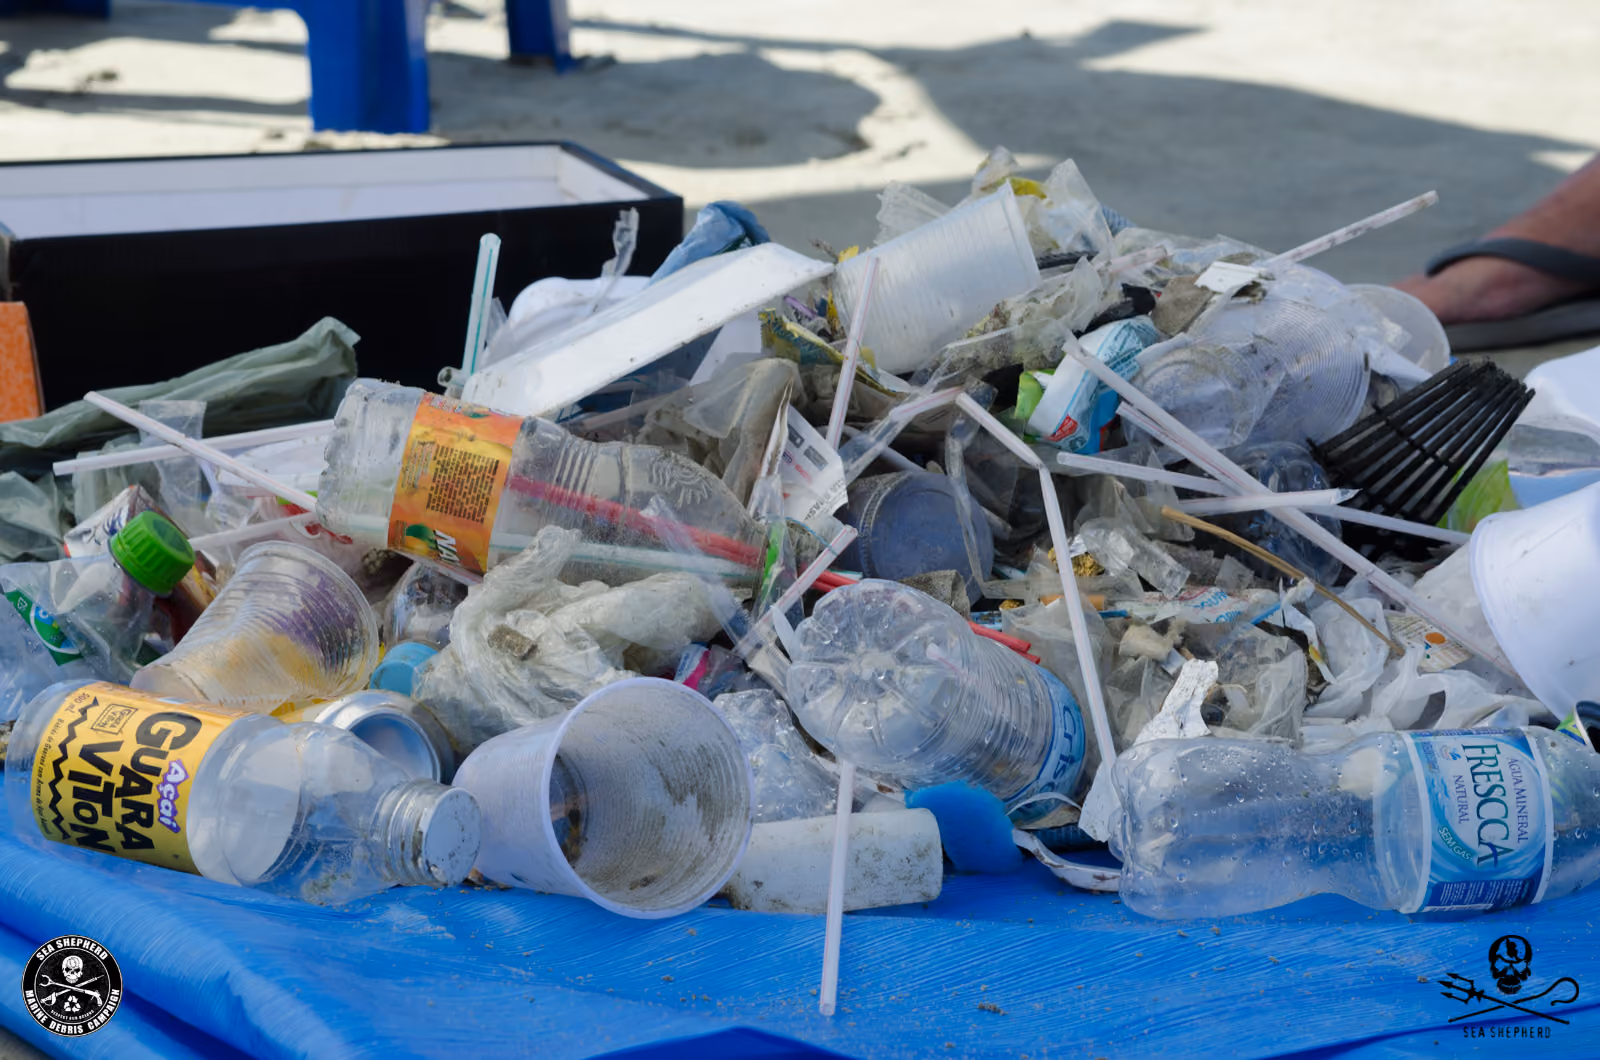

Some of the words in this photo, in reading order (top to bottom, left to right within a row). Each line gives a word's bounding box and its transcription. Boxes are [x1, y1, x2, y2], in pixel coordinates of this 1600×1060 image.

[115, 711, 203, 850] GUARA
[1452, 774, 1471, 825] NATURAL
[1461, 743, 1515, 867] FRESCCA
[1438, 826, 1456, 847] SEM
[1453, 844, 1472, 861] GAS
[1513, 786, 1529, 844] MINERAL
